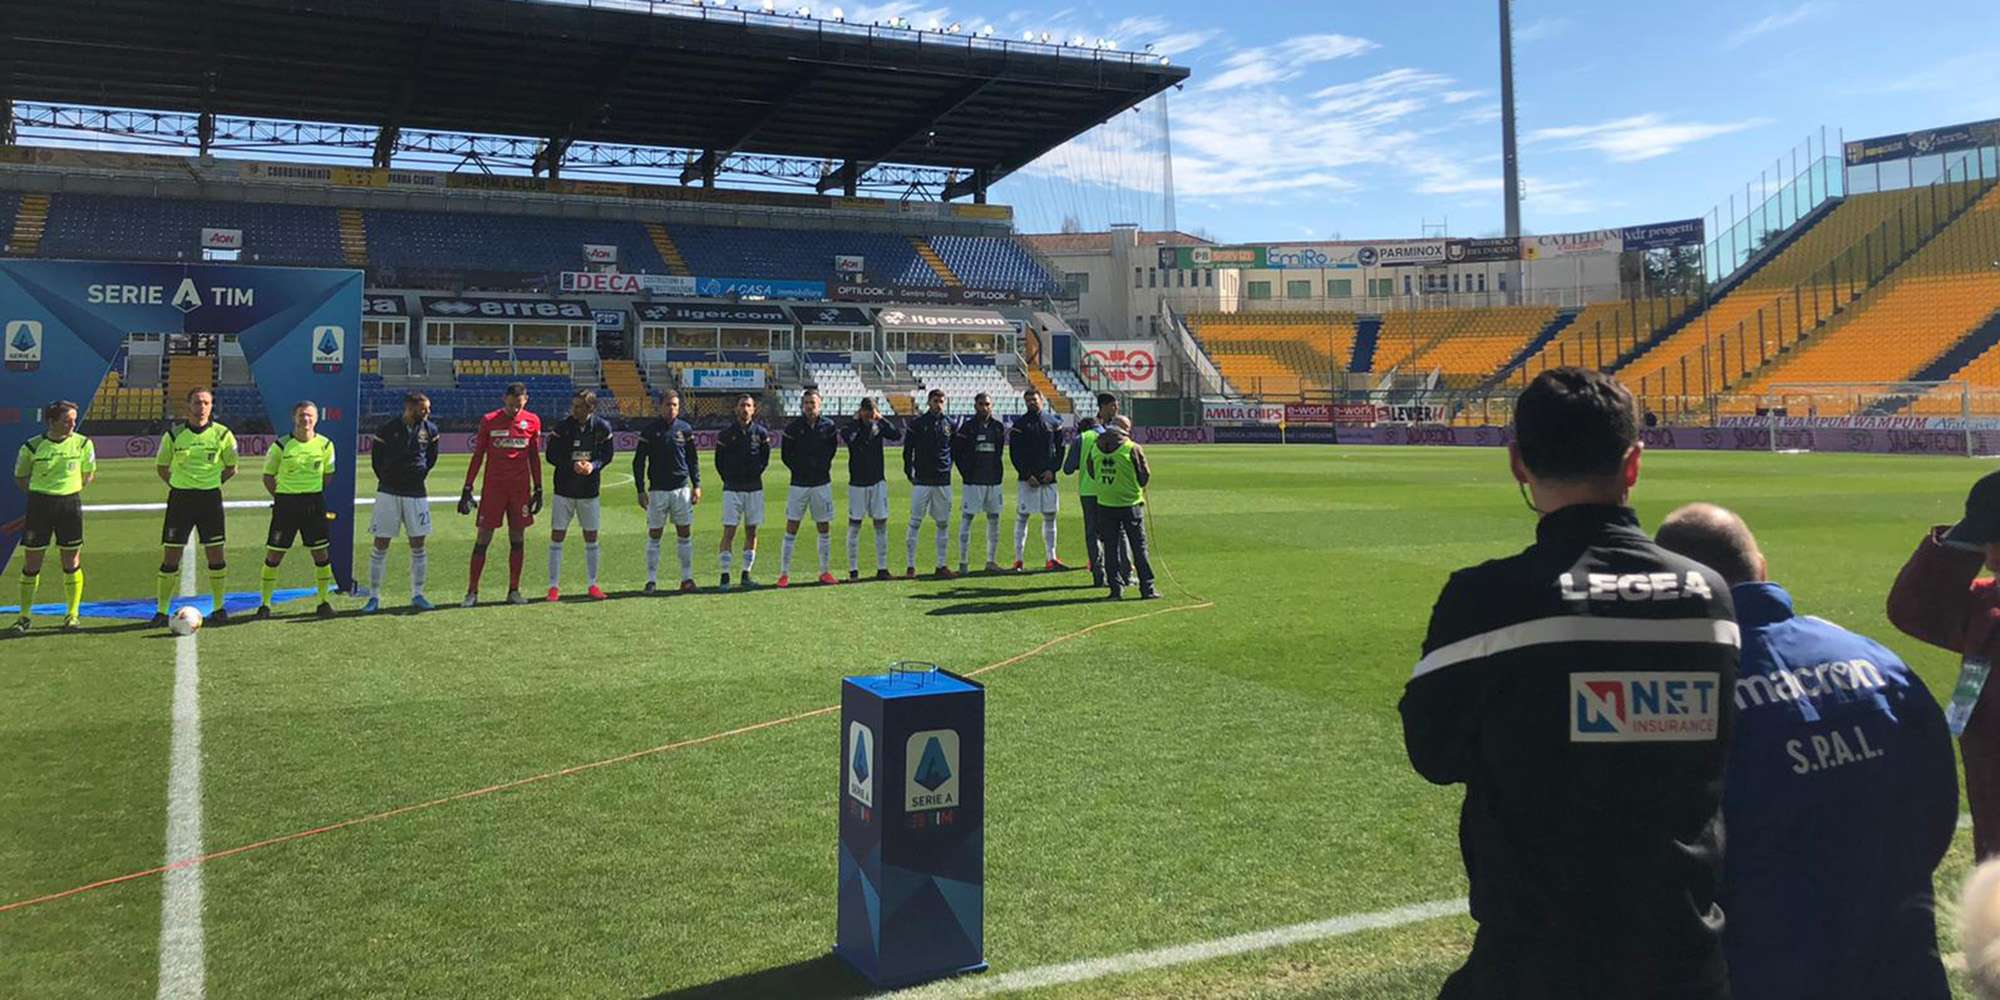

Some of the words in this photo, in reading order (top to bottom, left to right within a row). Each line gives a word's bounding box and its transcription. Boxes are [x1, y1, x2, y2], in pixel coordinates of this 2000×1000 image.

[1380, 245, 1443, 258] PARMINOX
[576, 274, 640, 292] DECA
[88, 284, 163, 304] SERIE
[211, 287, 254, 307] TIM
[838, 286, 885, 296] OPTILOOK
[963, 290, 1007, 300] OPTILOOK
[1205, 406, 1244, 419] AMICA
[1249, 405, 1283, 419] CHIPS
[1286, 404, 1329, 416] e-work
[1333, 404, 1373, 416] e-work
[1784, 416, 1850, 428] WAMPUM
[1853, 416, 1928, 428] WAMPUM
[1101, 475, 1115, 485] TV
[1559, 571, 1713, 600] LEGEA
[1734, 659, 1886, 710] macron
[1631, 681, 1714, 714] NET
[1632, 719, 1714, 733] INSURANCE
[1786, 726, 1884, 774] S.P.A.L.
[911, 794, 942, 807] SERIE
[945, 791, 954, 803] A
